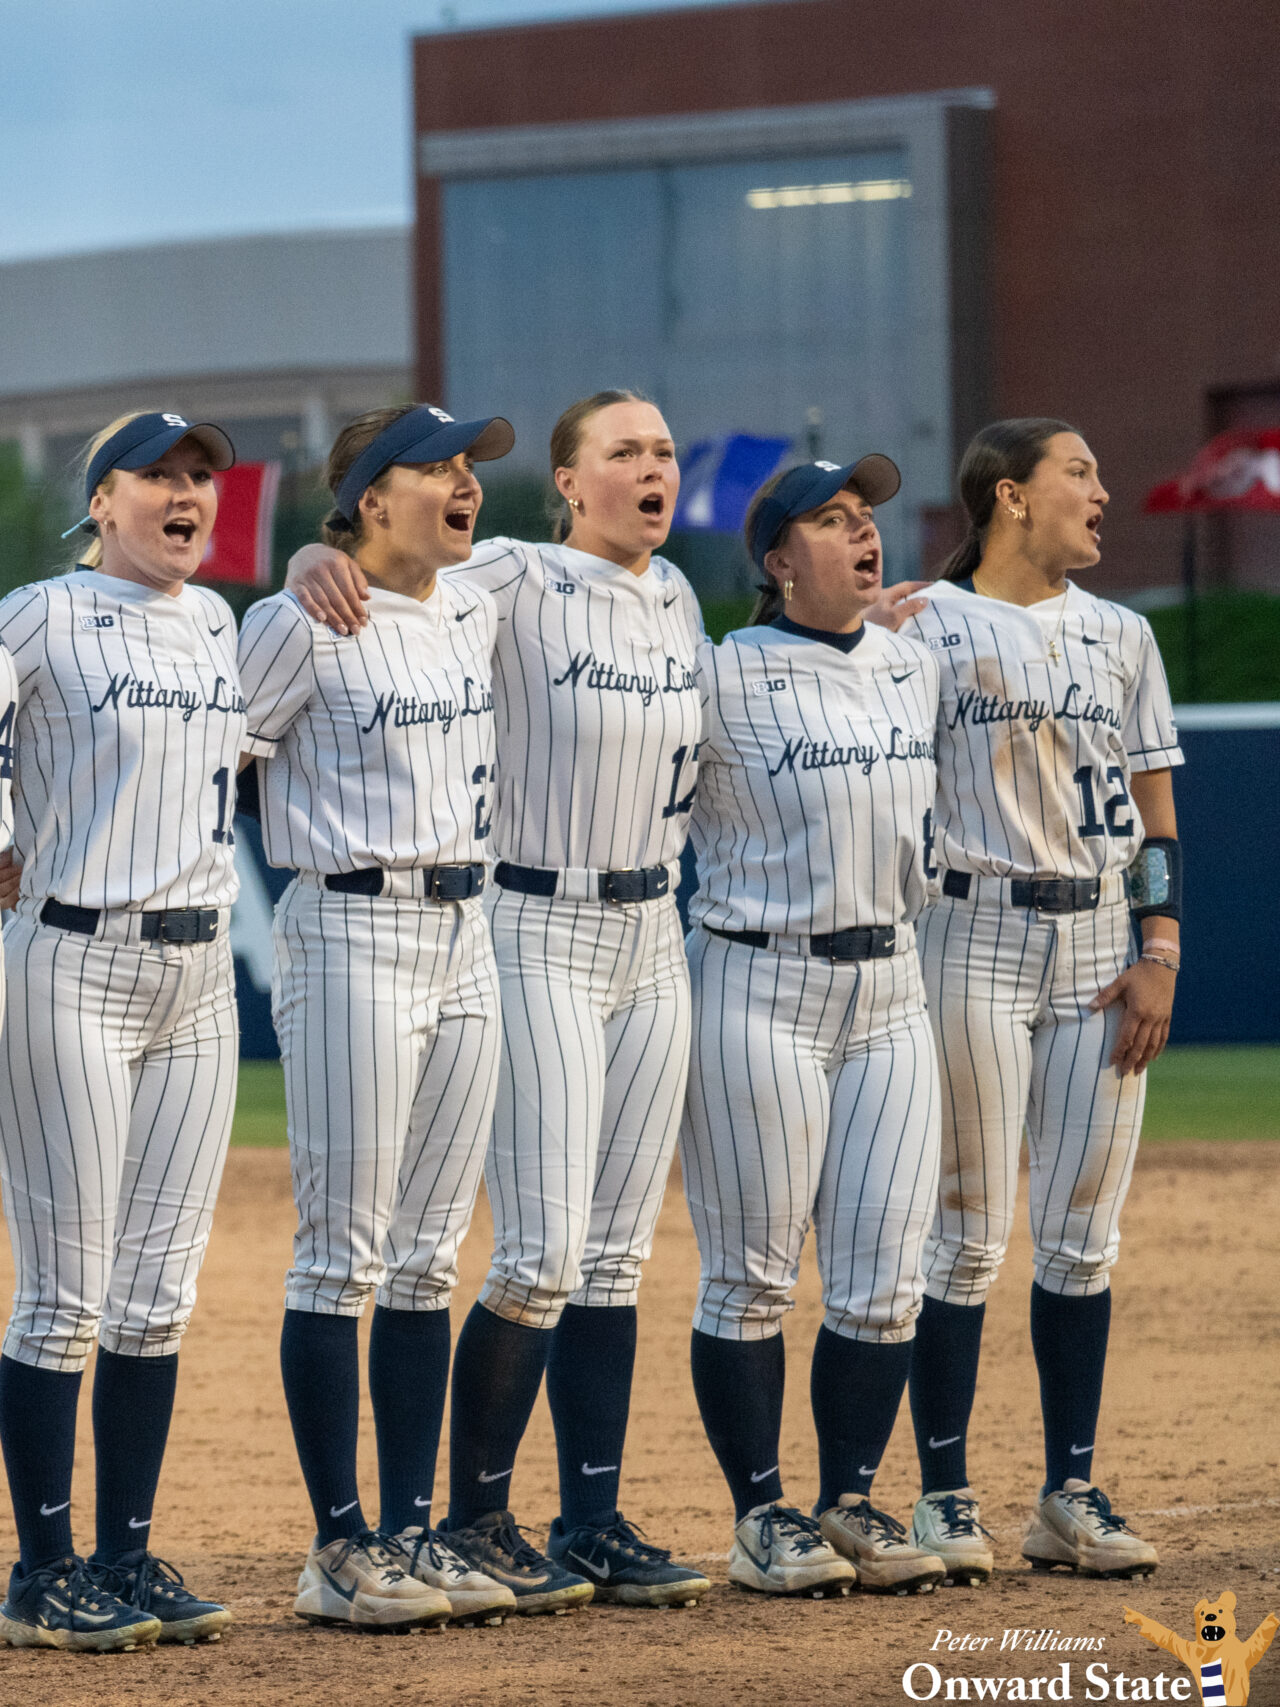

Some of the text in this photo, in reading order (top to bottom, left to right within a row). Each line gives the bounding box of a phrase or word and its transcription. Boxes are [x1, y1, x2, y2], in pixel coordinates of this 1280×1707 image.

[93, 672, 201, 721] Nittany
[554, 651, 657, 706] Nittany
[362, 691, 456, 733] Nittany
[949, 683, 1122, 732] Nittany Lions
[769, 737, 879, 776] Nittany
[1073, 765, 1134, 838] 12
